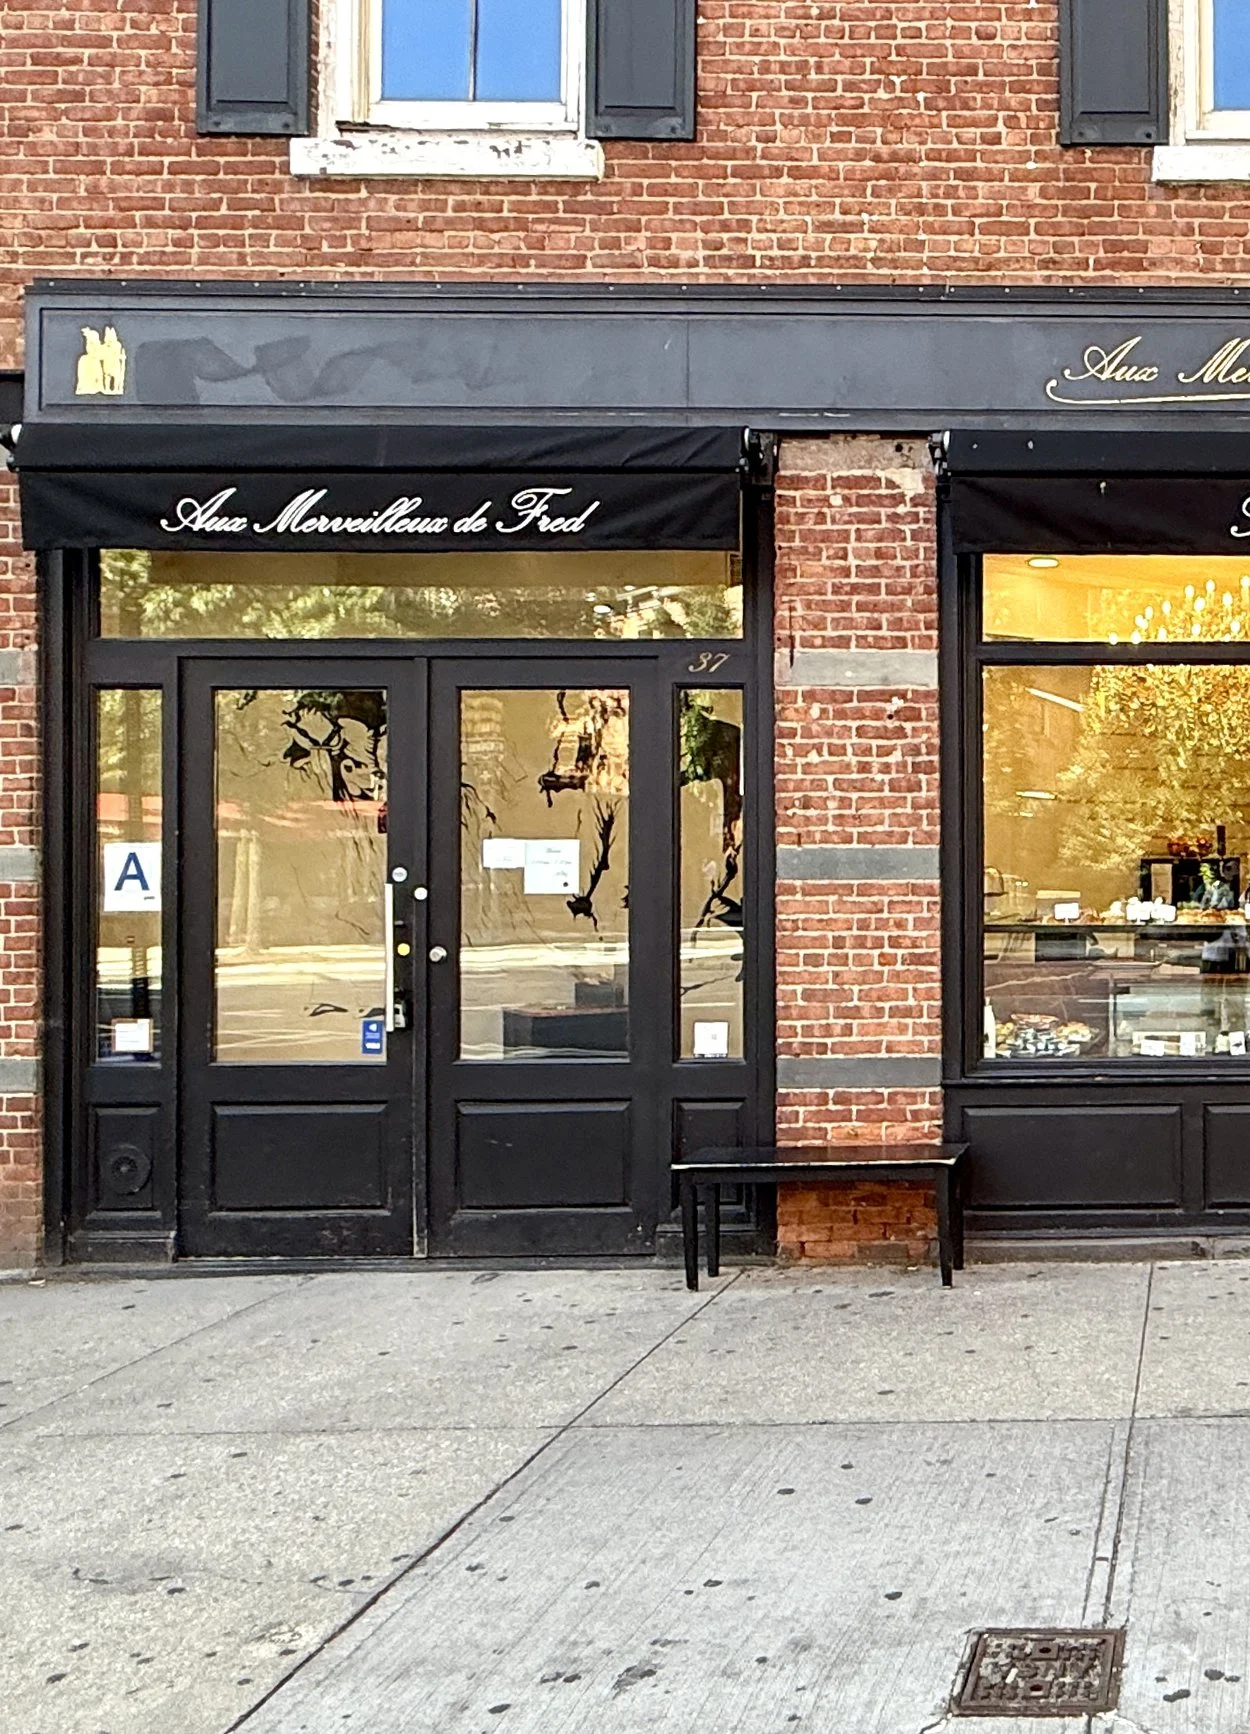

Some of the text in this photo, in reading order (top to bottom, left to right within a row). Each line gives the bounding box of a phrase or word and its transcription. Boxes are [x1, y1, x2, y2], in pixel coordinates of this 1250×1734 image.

[1063, 335, 1159, 382] Aux
[159, 487, 600, 534] Aux Merveilleux de Fred
[688, 651, 731, 673] 37
[113, 851, 150, 892] A
